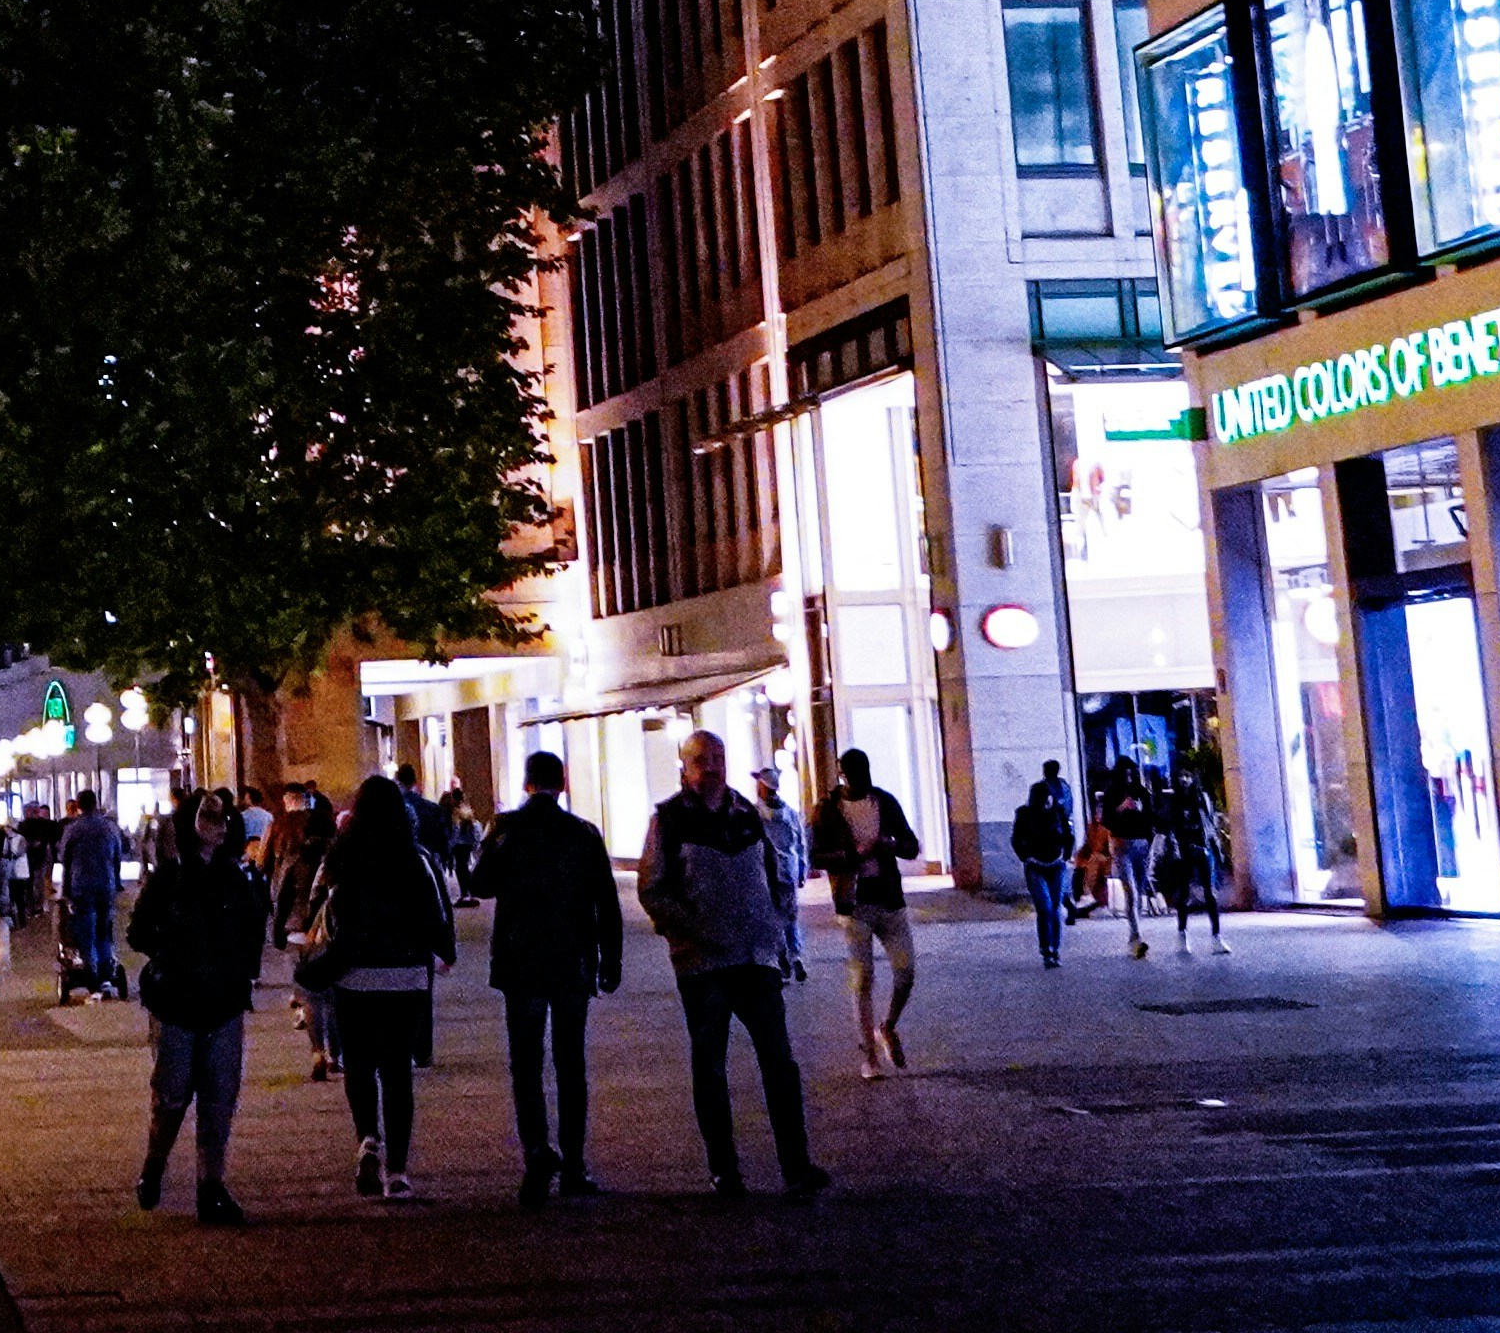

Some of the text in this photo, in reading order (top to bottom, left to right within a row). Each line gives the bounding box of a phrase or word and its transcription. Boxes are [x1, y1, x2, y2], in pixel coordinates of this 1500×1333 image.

[1211, 373, 1294, 443] UNITED
[1294, 344, 1391, 423] COLORS
[1388, 332, 1428, 397] OF
